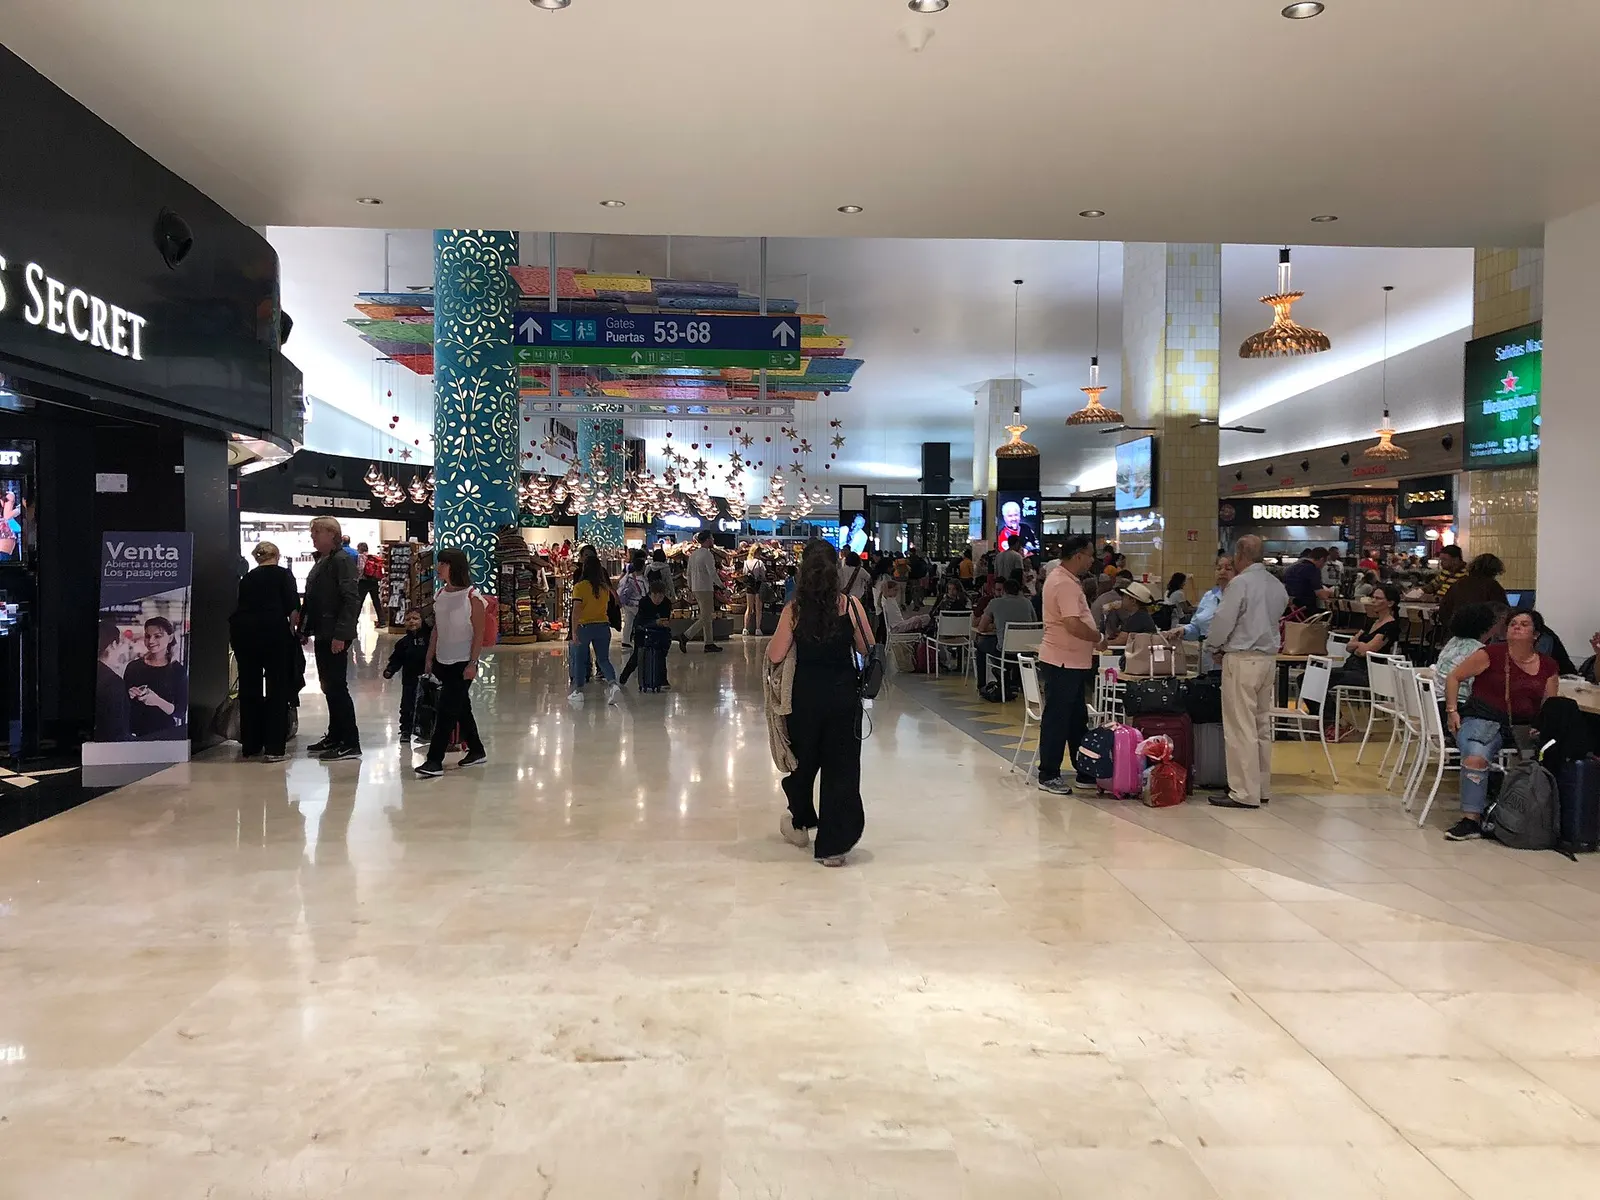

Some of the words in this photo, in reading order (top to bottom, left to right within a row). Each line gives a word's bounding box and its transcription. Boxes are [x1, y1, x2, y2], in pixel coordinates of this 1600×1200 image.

[24, 262, 147, 360] SECRET
[605, 317, 635, 329] Gates
[654, 321, 711, 343] 53-68
[605, 331, 645, 343] Puertas
[1503, 437, 1518, 454] 53
[1253, 504, 1321, 519] BURGERS
[106, 541, 179, 560] Venta
[105, 560, 140, 568] Abierta
[151, 560, 178, 568] todos
[104, 568, 123, 577] Los
[125, 569, 178, 580] pasajeros
